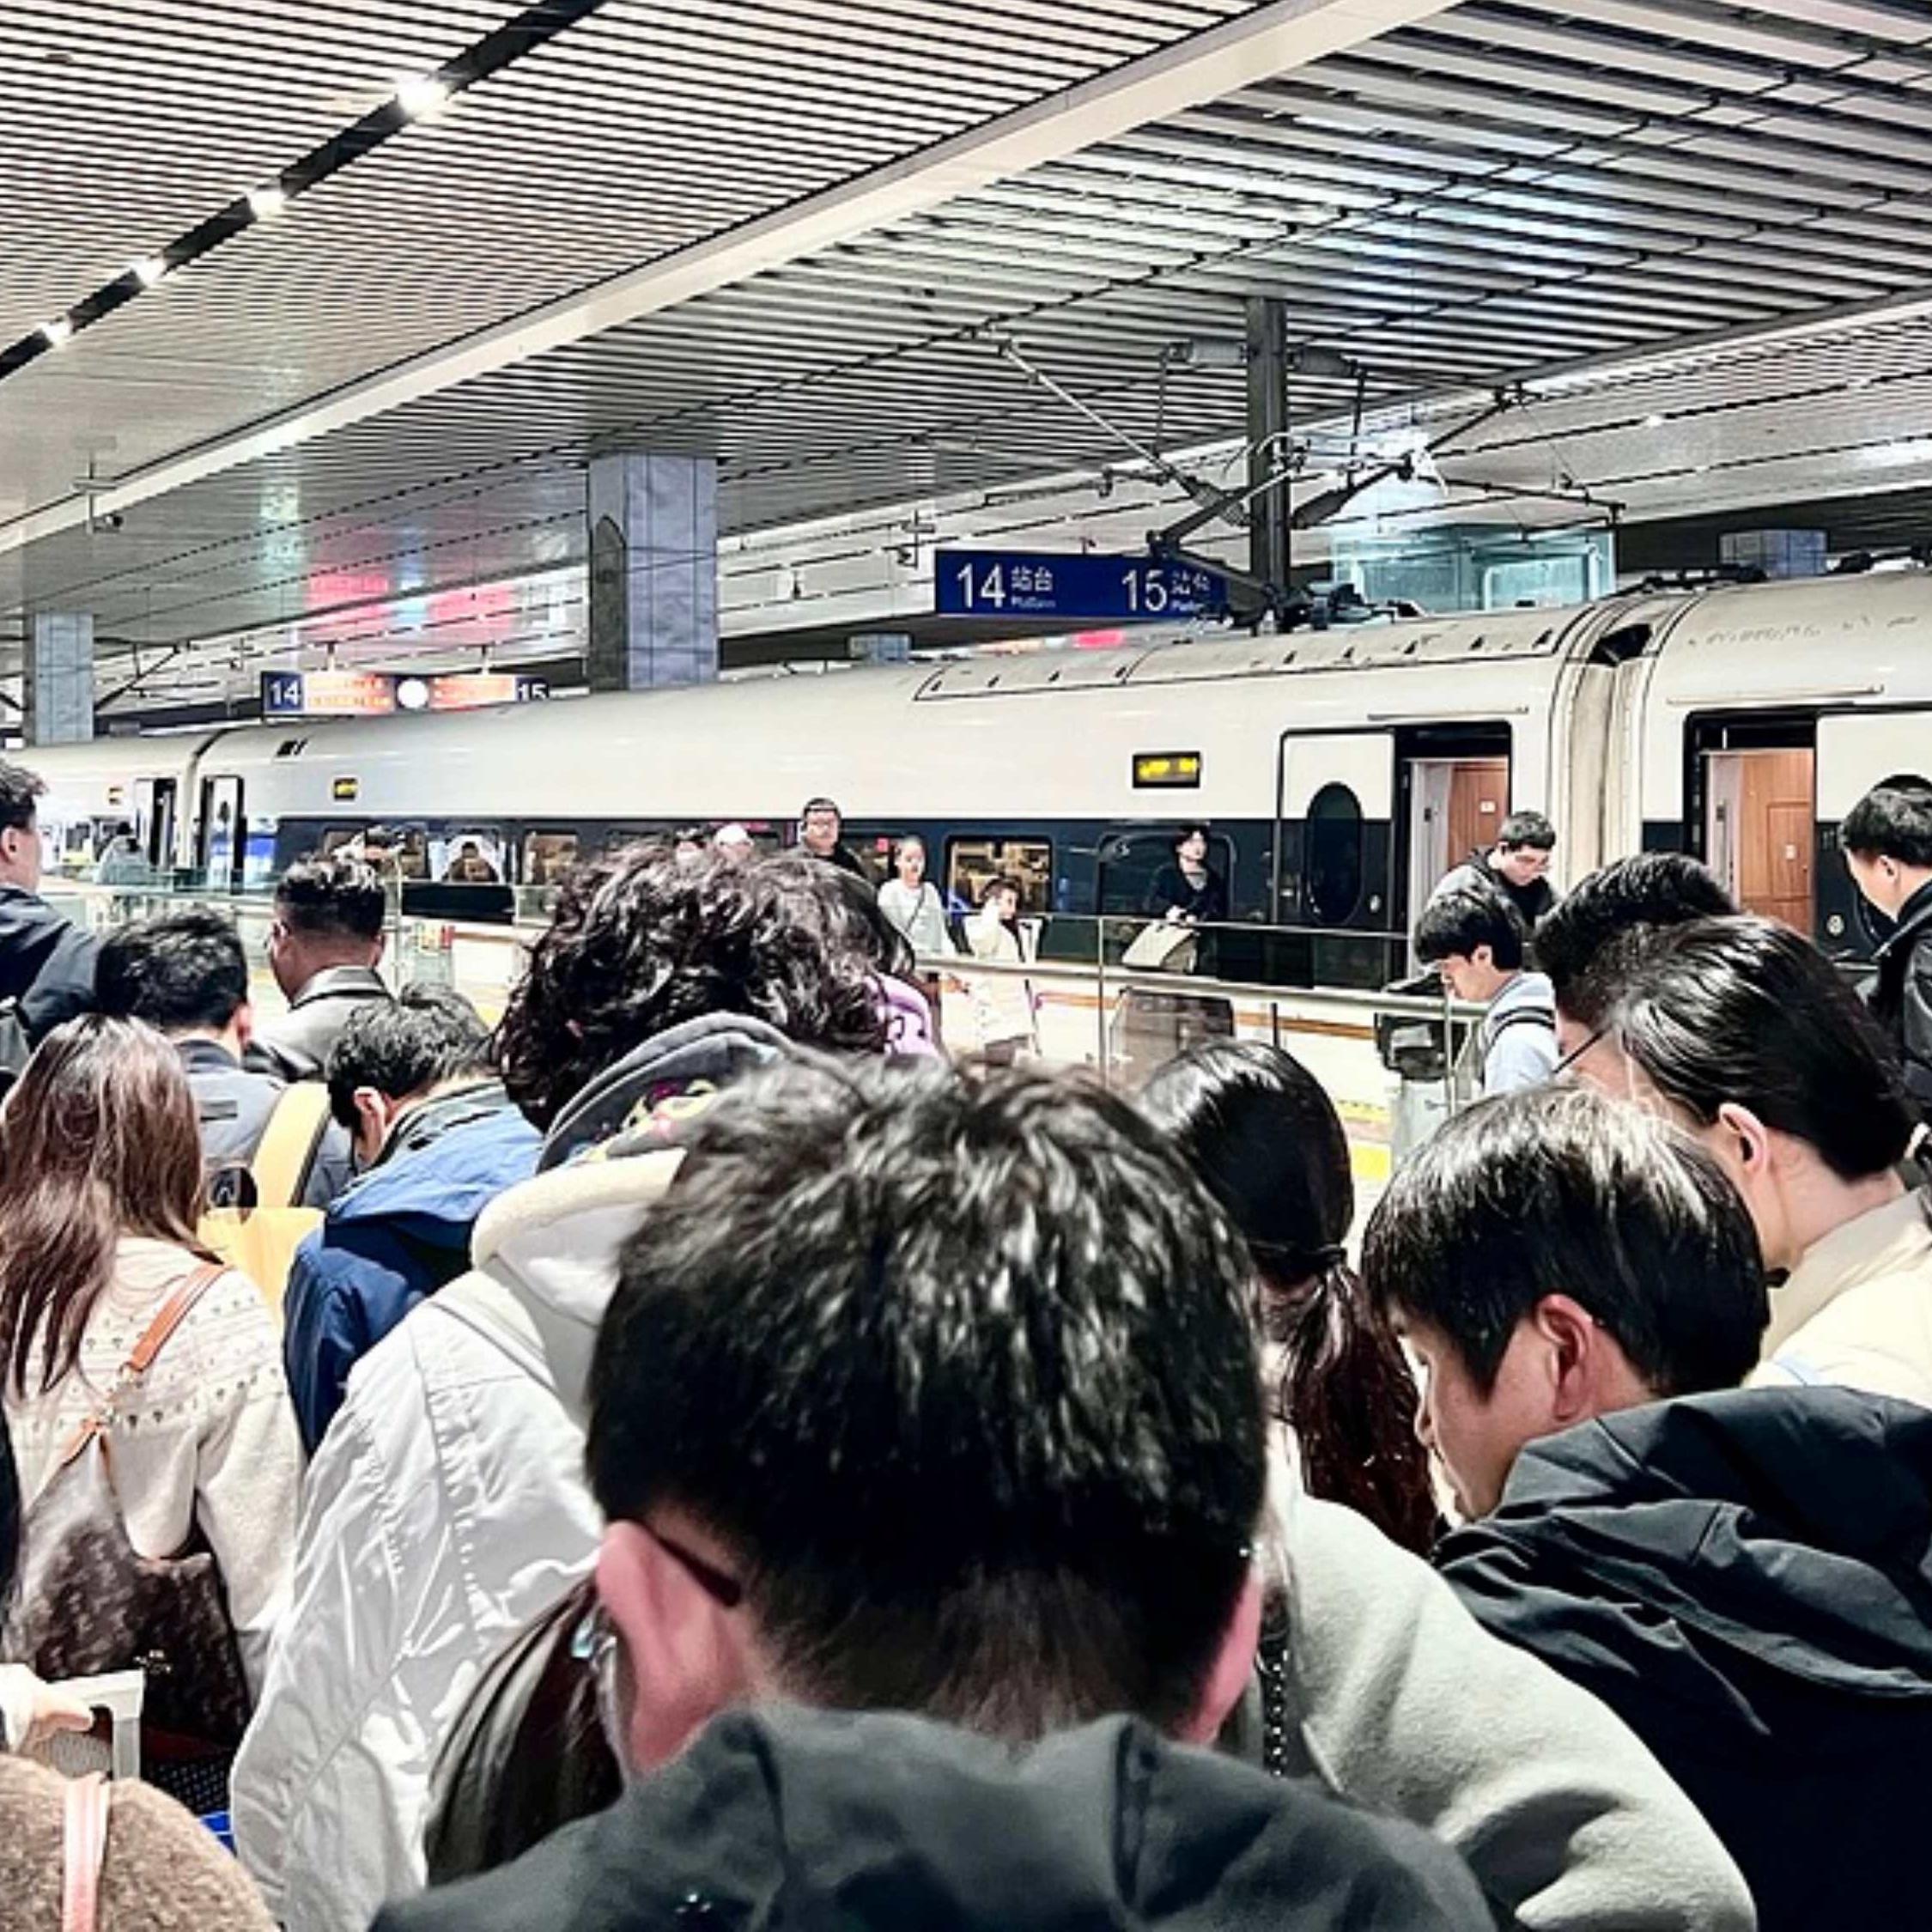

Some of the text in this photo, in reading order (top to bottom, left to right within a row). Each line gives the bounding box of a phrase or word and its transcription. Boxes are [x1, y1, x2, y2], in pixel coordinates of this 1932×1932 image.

[957, 563, 1053, 608] 14 站台
[1121, 569, 1167, 611] 15
[270, 680, 301, 706] 14
[518, 683, 548, 700] 15
